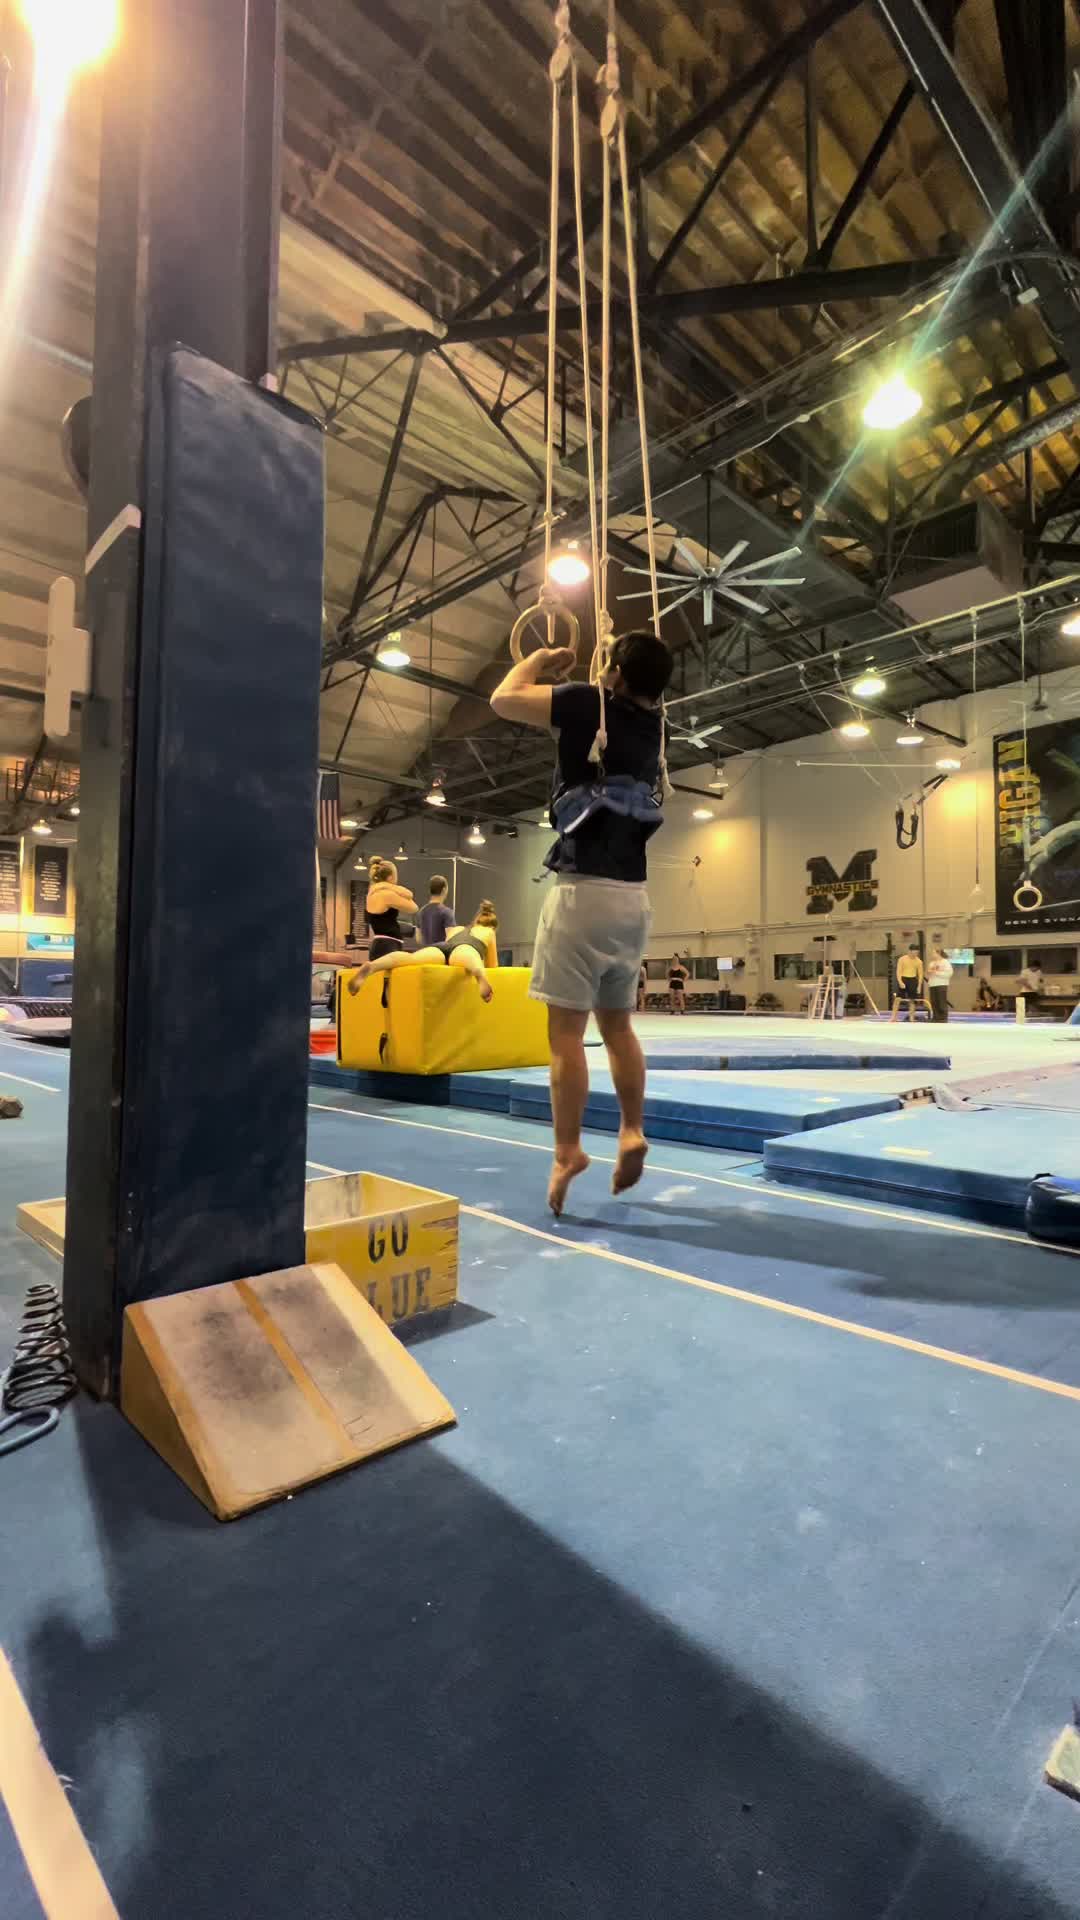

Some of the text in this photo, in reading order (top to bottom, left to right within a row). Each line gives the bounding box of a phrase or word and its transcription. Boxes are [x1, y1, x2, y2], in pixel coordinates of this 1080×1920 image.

[806, 849, 878, 915] M
[806, 880, 879, 897] GYMNASTICS
[368, 1211, 408, 1264] GO
[367, 1266, 431, 1319] LUE
